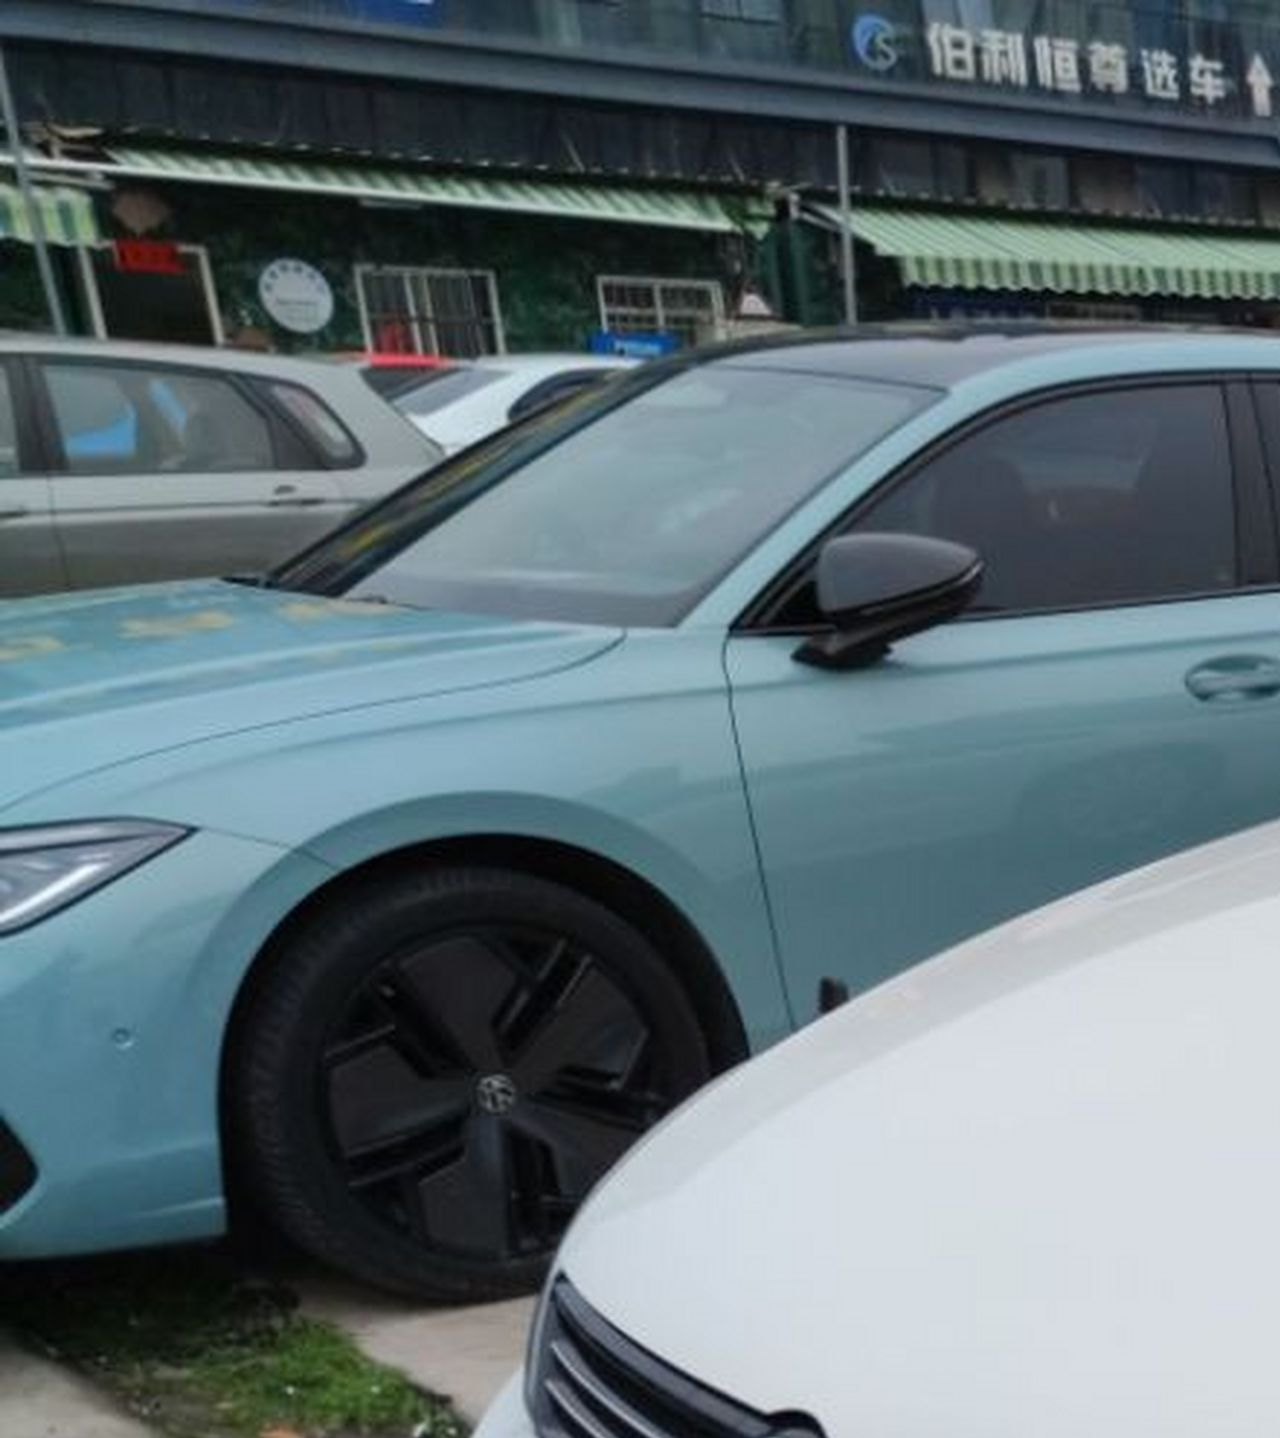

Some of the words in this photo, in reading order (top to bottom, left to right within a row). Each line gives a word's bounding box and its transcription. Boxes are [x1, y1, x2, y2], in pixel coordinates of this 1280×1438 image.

[926, 21, 1227, 104] 伯利恒尊选车
